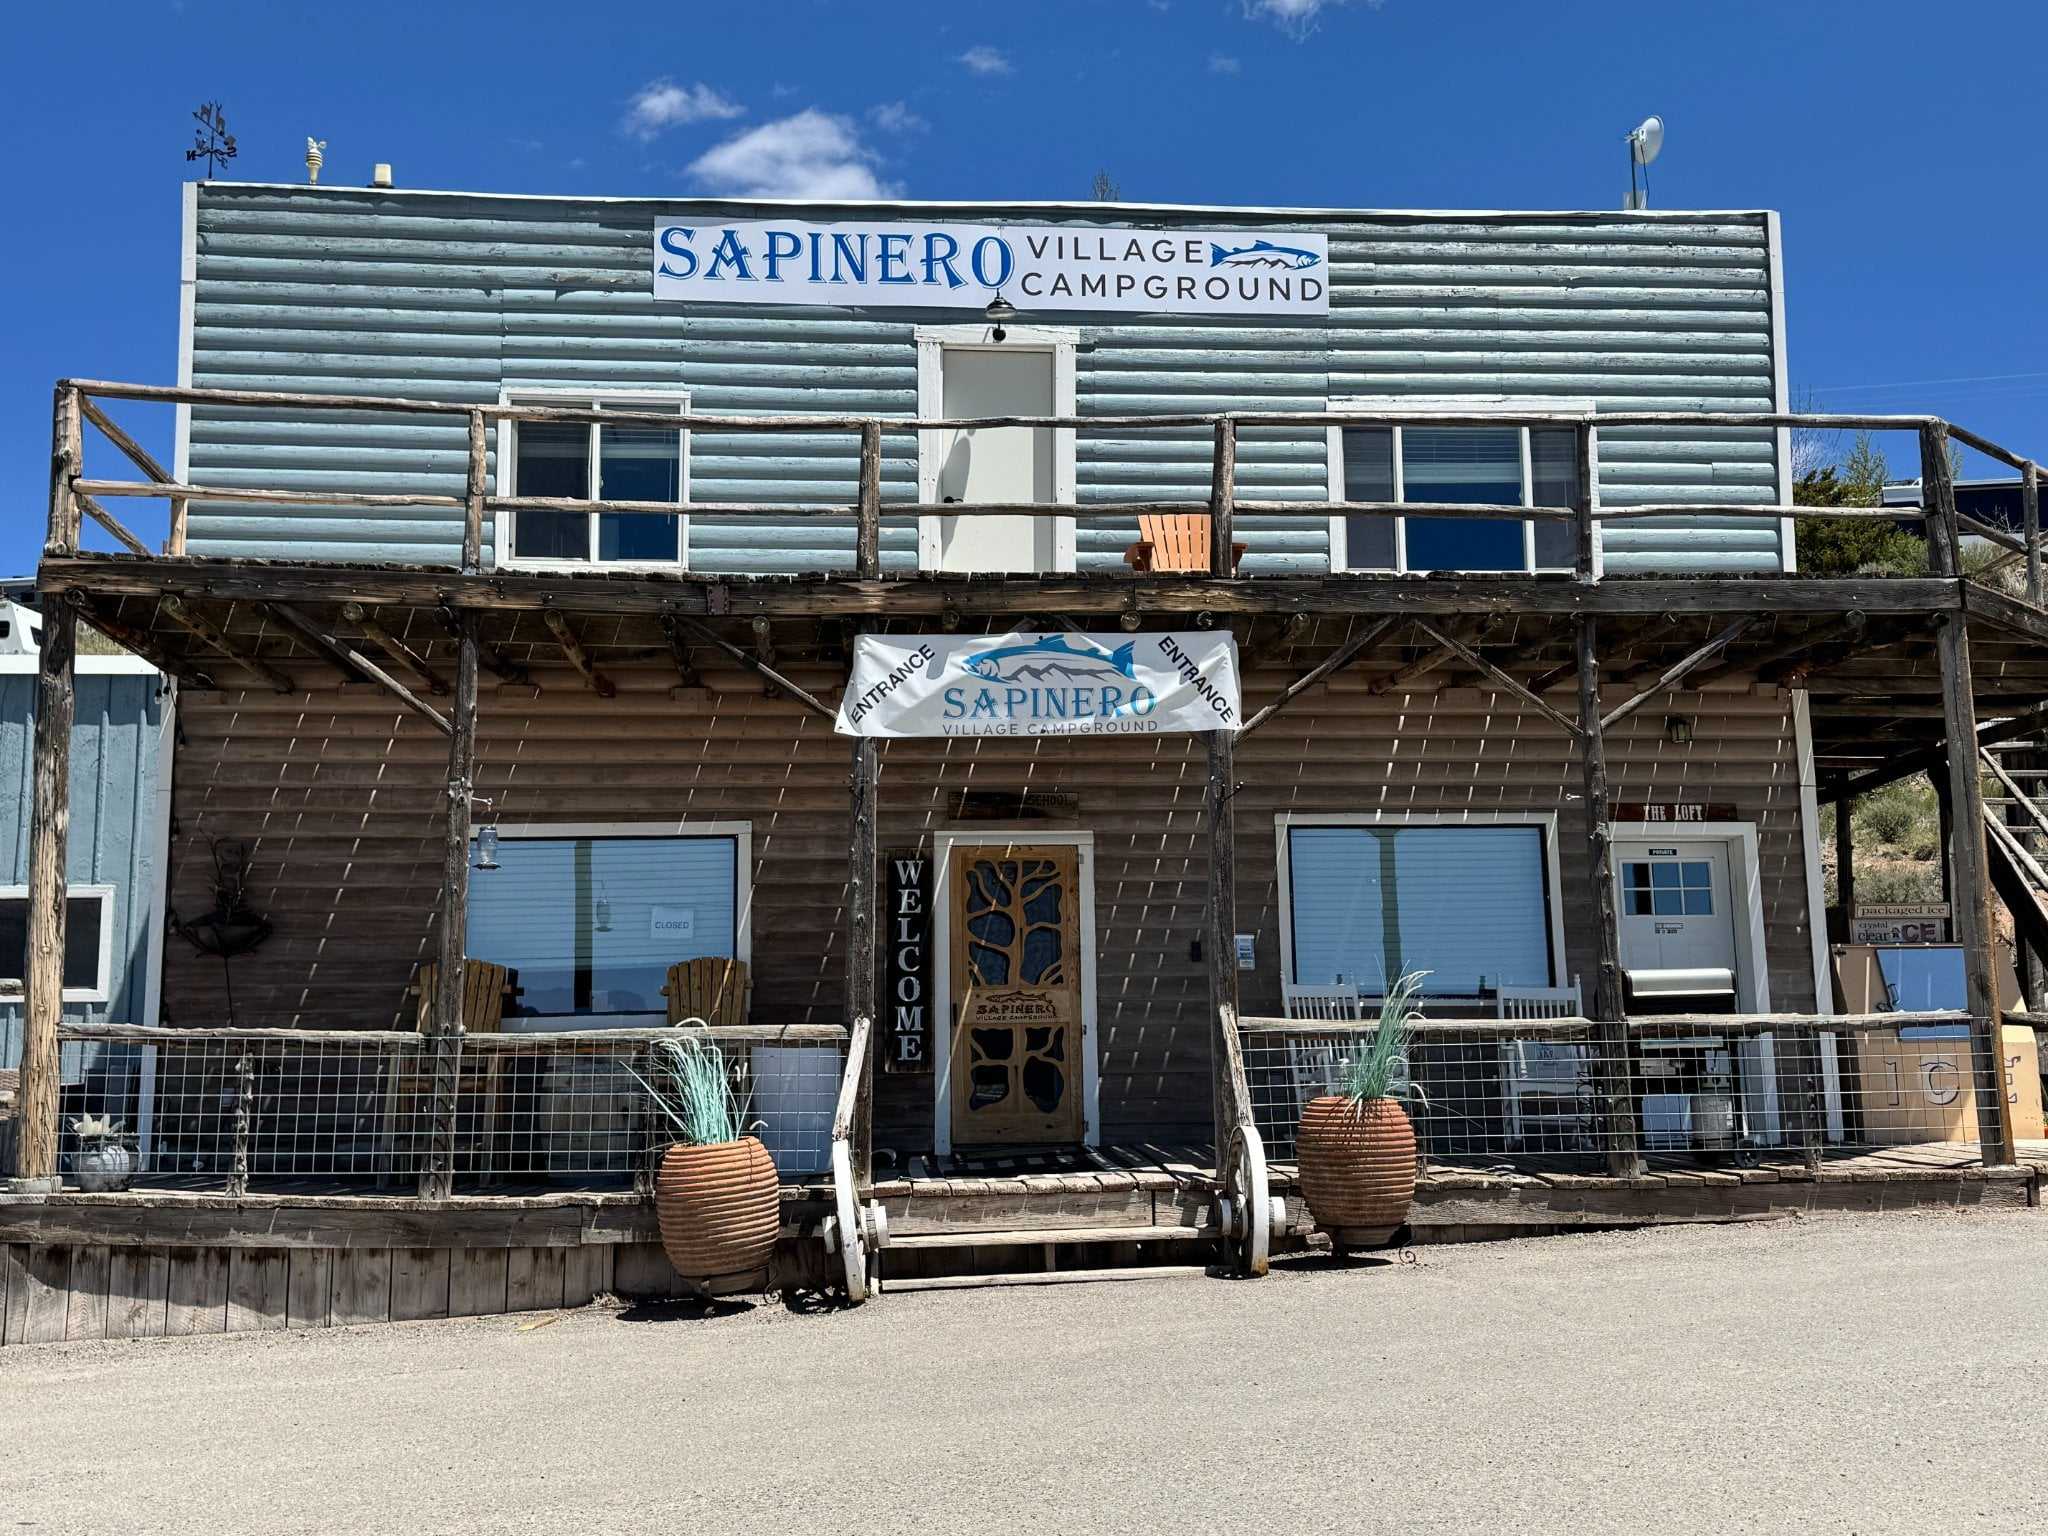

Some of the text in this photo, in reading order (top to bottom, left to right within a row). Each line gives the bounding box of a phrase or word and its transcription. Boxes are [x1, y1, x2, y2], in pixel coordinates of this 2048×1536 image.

[658, 226, 1016, 290] SAPINERO
[1026, 235, 1203, 264] VILLAGE
[1021, 271, 1324, 302] CAMPGROUND
[850, 643, 935, 725] ENTRANCE
[1157, 635, 1234, 724] ENTRANCE
[942, 685, 1158, 721] SAPINERO
[942, 719, 1158, 736] VILLAGE CAMPGROUND
[1643, 804, 1703, 821] THE LOFT
[1861, 906, 1945, 916] packaged ice
[654, 921, 689, 929] CLOSED
[1857, 929, 1889, 942] clear
[1858, 920, 1888, 929] crystal
[894, 859, 924, 1061] WELCOME
[975, 1004, 1057, 1017] SAPINERO
